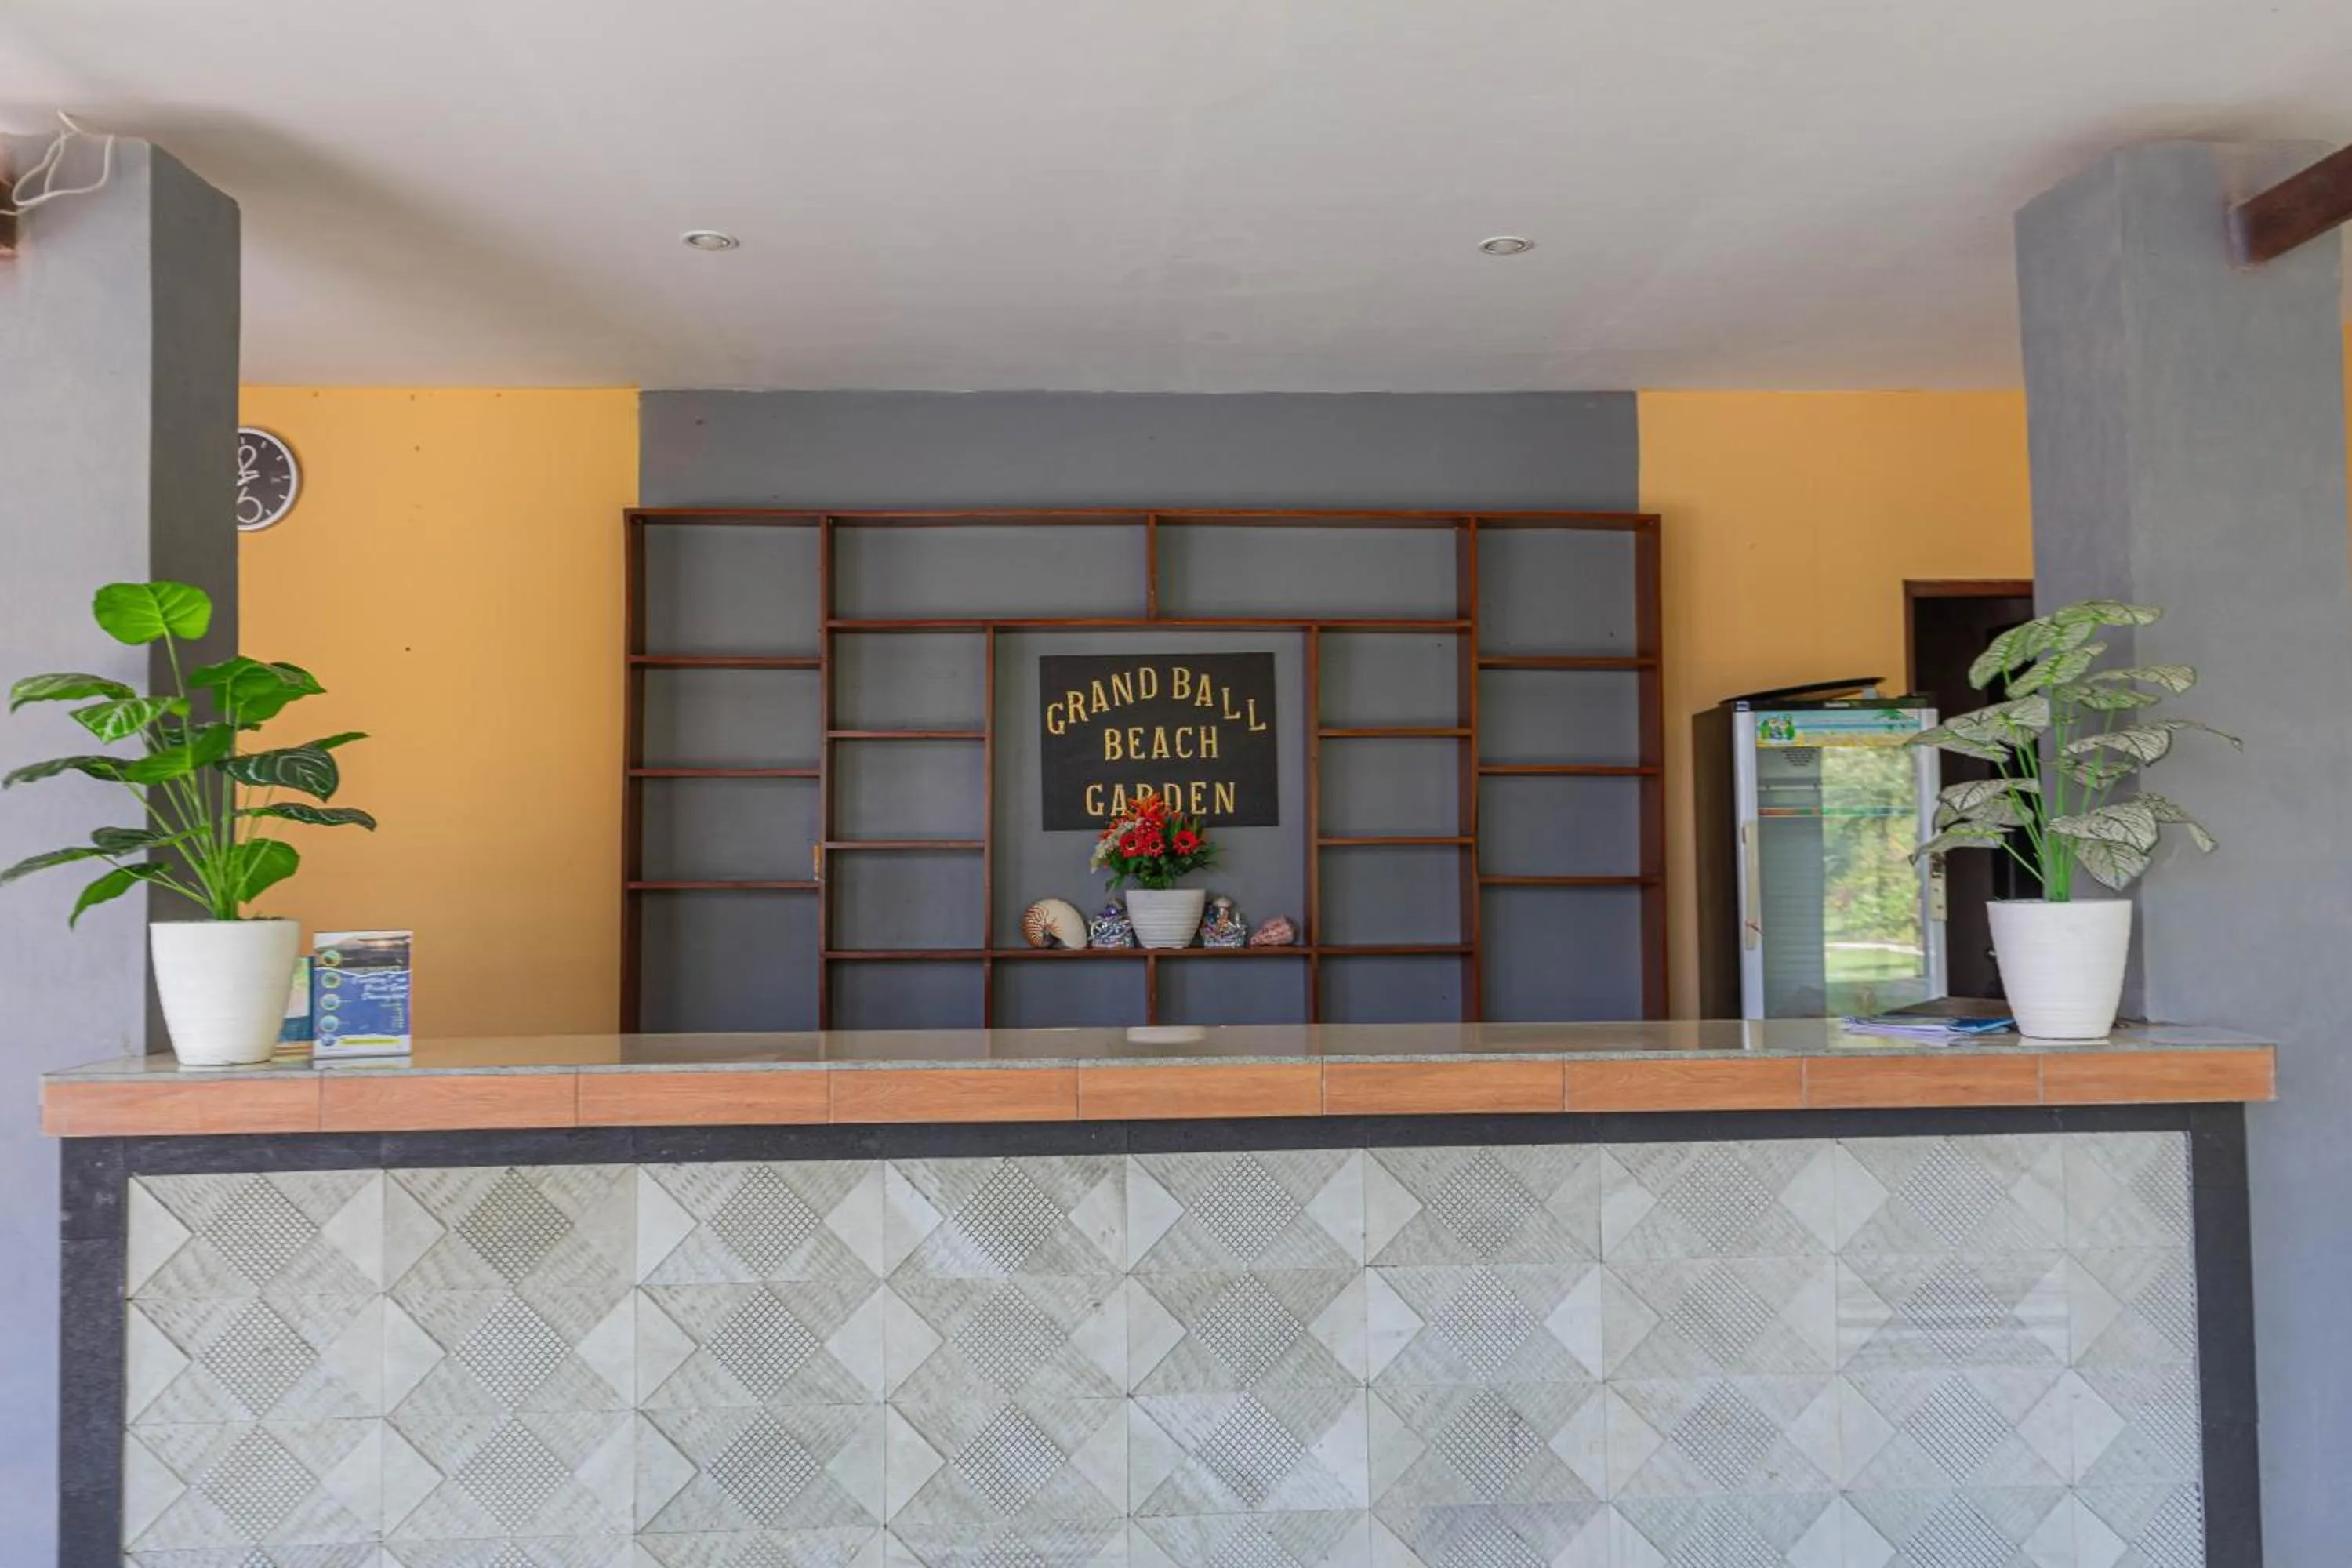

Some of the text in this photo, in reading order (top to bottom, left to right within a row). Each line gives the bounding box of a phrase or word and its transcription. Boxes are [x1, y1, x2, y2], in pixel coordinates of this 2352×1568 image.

[1047, 667, 1267, 735] GRAND BALL
[1104, 725, 1219, 760] BEACH
